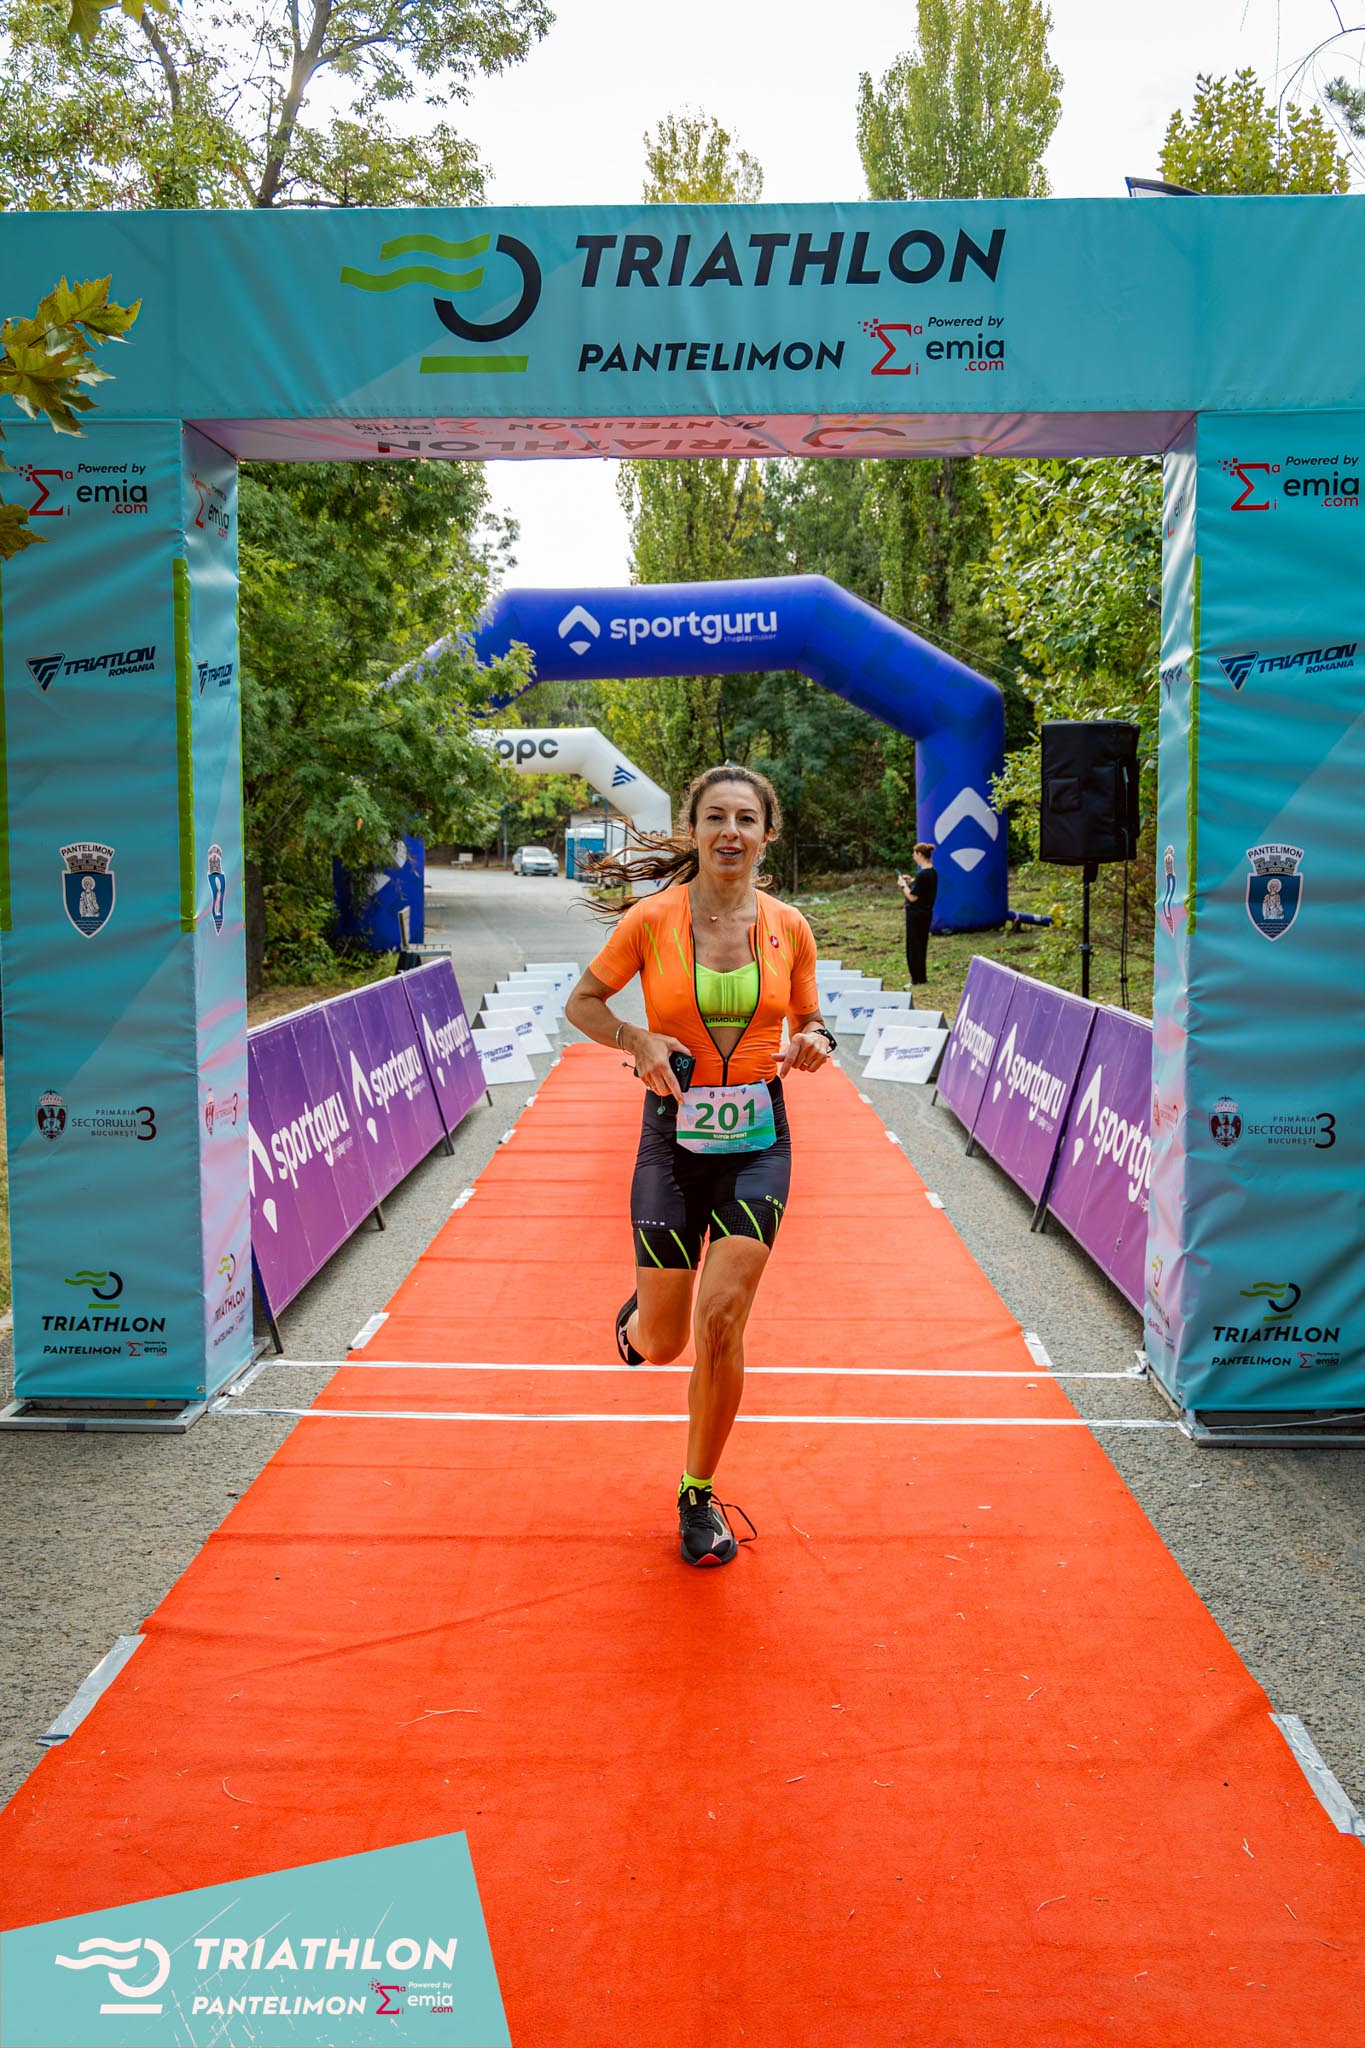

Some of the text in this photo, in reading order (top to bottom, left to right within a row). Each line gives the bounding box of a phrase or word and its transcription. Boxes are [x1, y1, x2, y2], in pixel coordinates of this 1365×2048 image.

[576, 228, 1006, 287] TRIATHLON
[928, 315, 1004, 328] Powered by
[926, 333, 1004, 360] emia
[578, 340, 845, 372] PANTELIMON
[965, 360, 1004, 371] .com
[377, 439, 769, 453] TRIATHLON
[78, 463, 146, 475] Powered by
[1286, 454, 1359, 467] Powered by
[76, 479, 148, 503] emia
[1283, 471, 1359, 496] emia
[111, 503, 148, 514] .com
[1320, 496, 1359, 507] .com
[610, 611, 778, 646] sportguru
[64, 646, 156, 676] TRIATLON
[1258, 643, 1358, 674] TRIATLON
[108, 662, 155, 677] ROMANIA
[1305, 660, 1355, 675] ROMANIA
[61, 844, 114, 857] PANTELIMON
[1247, 846, 1303, 859] PANTELIMON
[370, 1044, 423, 1114] sportguru
[1008, 1053, 1067, 1121] sportguru
[72, 1106, 157, 1141] SECTORULUI 3
[695, 1099, 755, 1131] 201
[1247, 1112, 1336, 1149] SECTORULUI 3
[271, 1091, 350, 1189] sportguru
[42, 1316, 166, 1332] TRIATHLON
[1213, 1326, 1340, 1343] TRIATHLON
[43, 1345, 121, 1355] PANTELIMON
[1212, 1356, 1291, 1366] PANTELIMON
